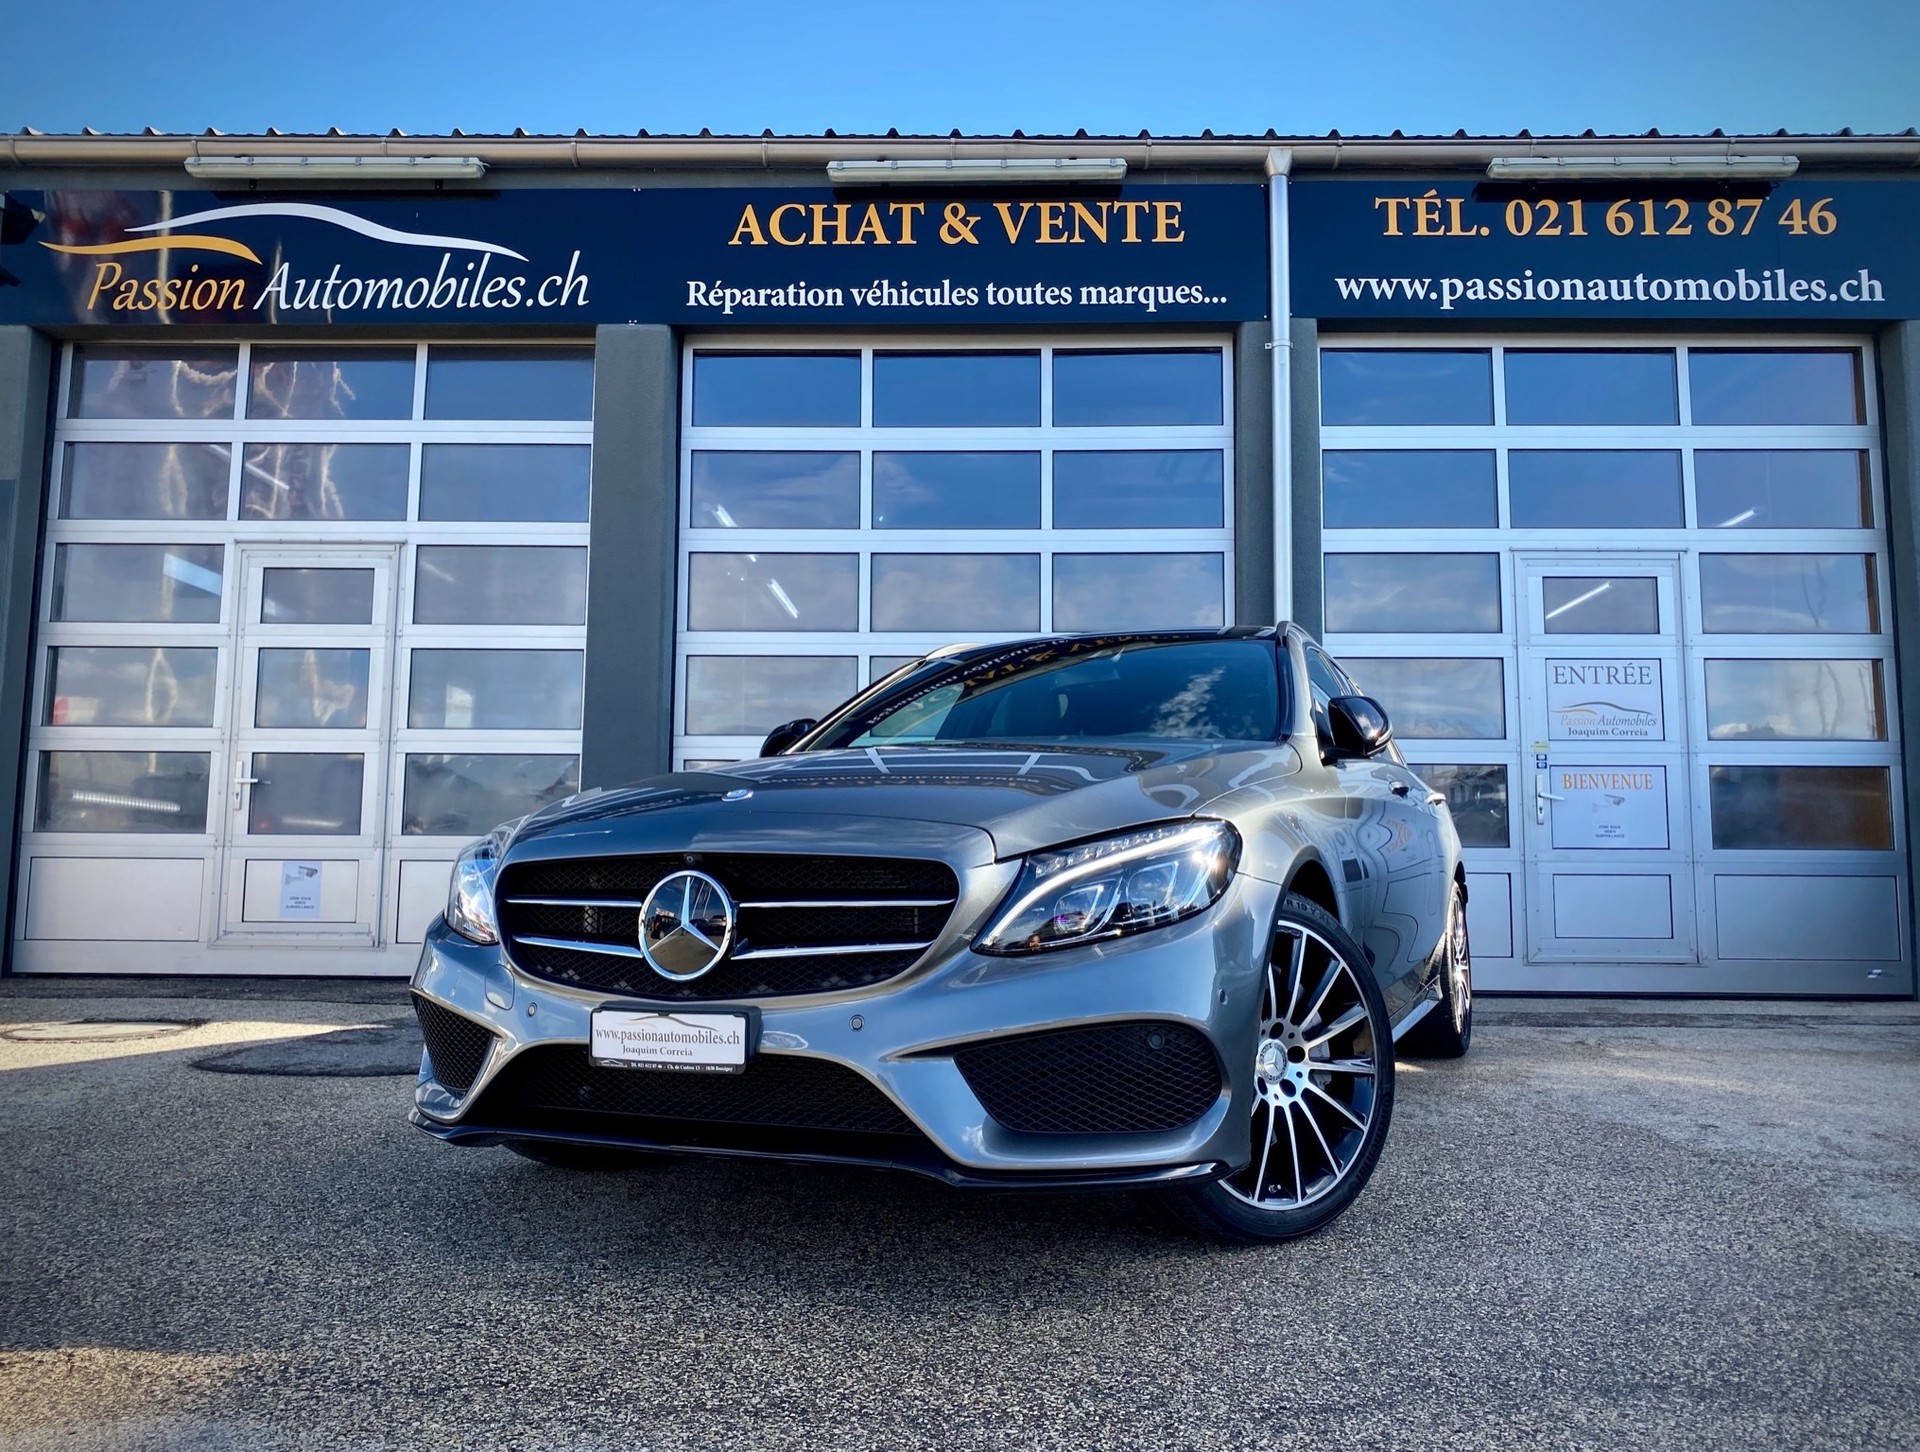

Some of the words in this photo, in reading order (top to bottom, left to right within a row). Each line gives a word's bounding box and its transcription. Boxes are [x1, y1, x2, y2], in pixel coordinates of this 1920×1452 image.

[729, 203, 925, 245] ACHAT
[939, 203, 980, 244] &
[993, 201, 1185, 243] VENTE
[1374, 189, 1490, 236] TÉL.
[1505, 198, 1588, 236] 021
[1605, 198, 1693, 236] 612
[1706, 198, 1764, 236] 87
[1778, 198, 1838, 236] 46
[87, 262, 245, 310] Passion
[252, 250, 589, 310] Automobiles.ch
[1335, 268, 1886, 310] www.passionautomobiles.ch
[686, 280, 847, 315] Réparation
[850, 279, 979, 307] véhicules
[985, 282, 1073, 306] toutes
[1079, 282, 1228, 314] marques...
[1553, 663, 1652, 686] ENTRÉE
[1561, 713, 1596, 727] Passion
[1597, 713, 1657, 727] Automobiles
[1568, 727, 1609, 738] Joaquim
[1611, 727, 1648, 737] Correia
[1562, 773, 1653, 790] BIENVENUE
[596, 1028, 740, 1045] www.passionautomobiles.ch
[622, 1045, 658, 1056] Joaquim
[659, 1046, 693, 1057] Correia
